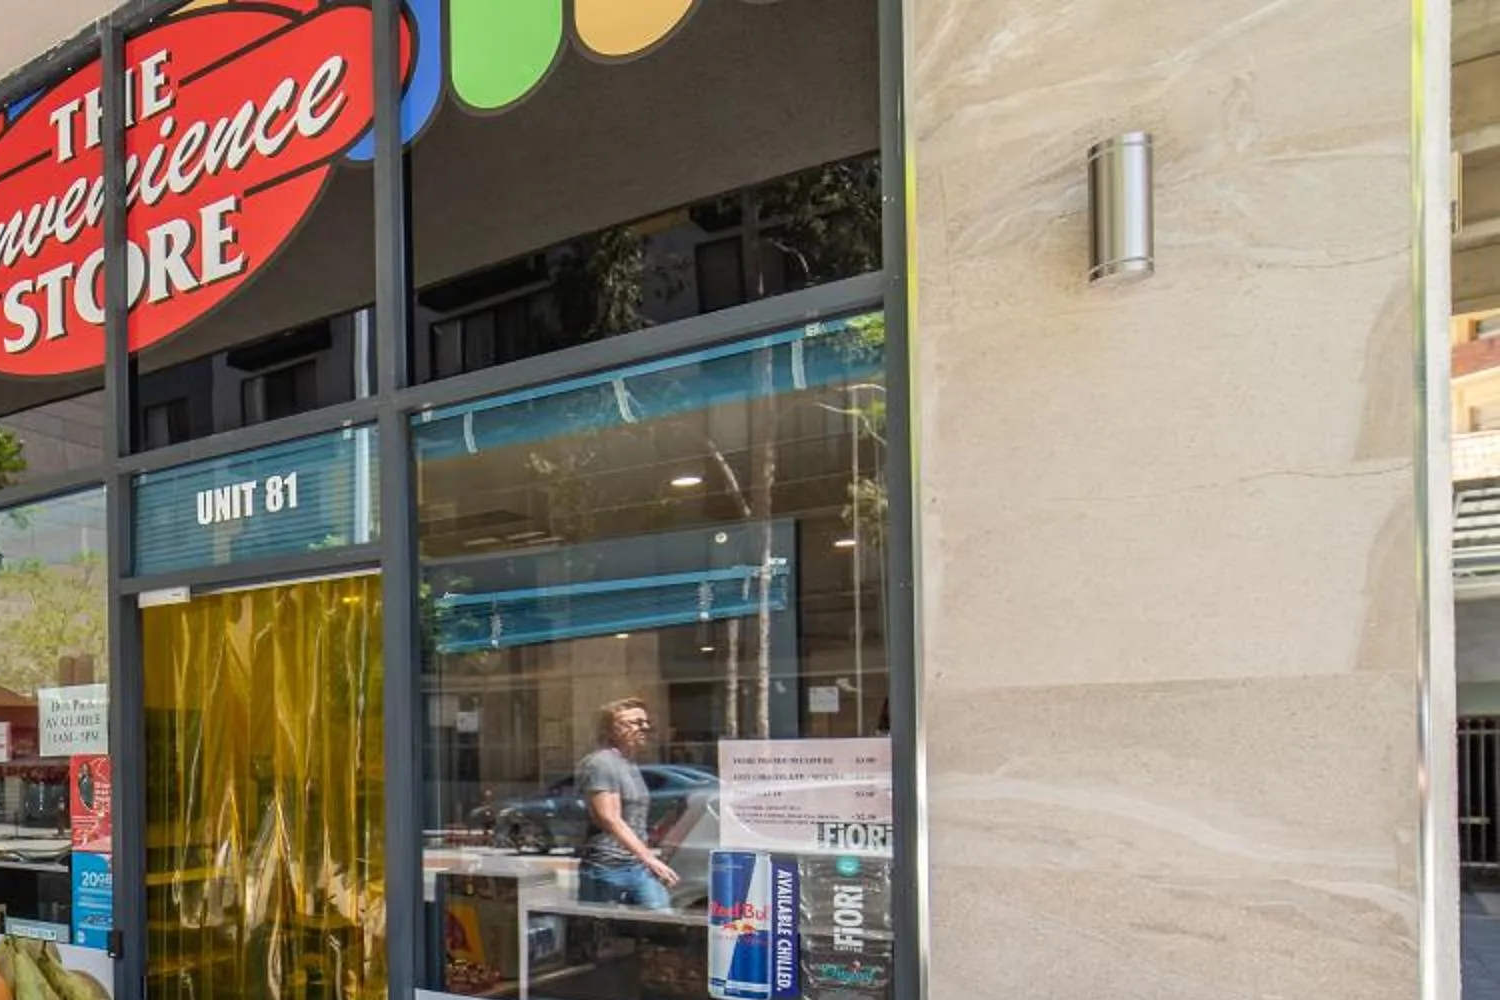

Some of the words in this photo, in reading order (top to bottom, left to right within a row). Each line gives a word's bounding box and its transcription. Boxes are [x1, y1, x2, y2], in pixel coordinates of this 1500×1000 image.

[51, 50, 174, 162] THE
[2, 195, 248, 355] STORE
[196, 480, 257, 525] UNIT
[264, 472, 300, 511] 81
[711, 901, 740, 918] Red
[776, 869, 793, 937] AVAILABLE
[776, 938, 793, 992] CHILLED.
